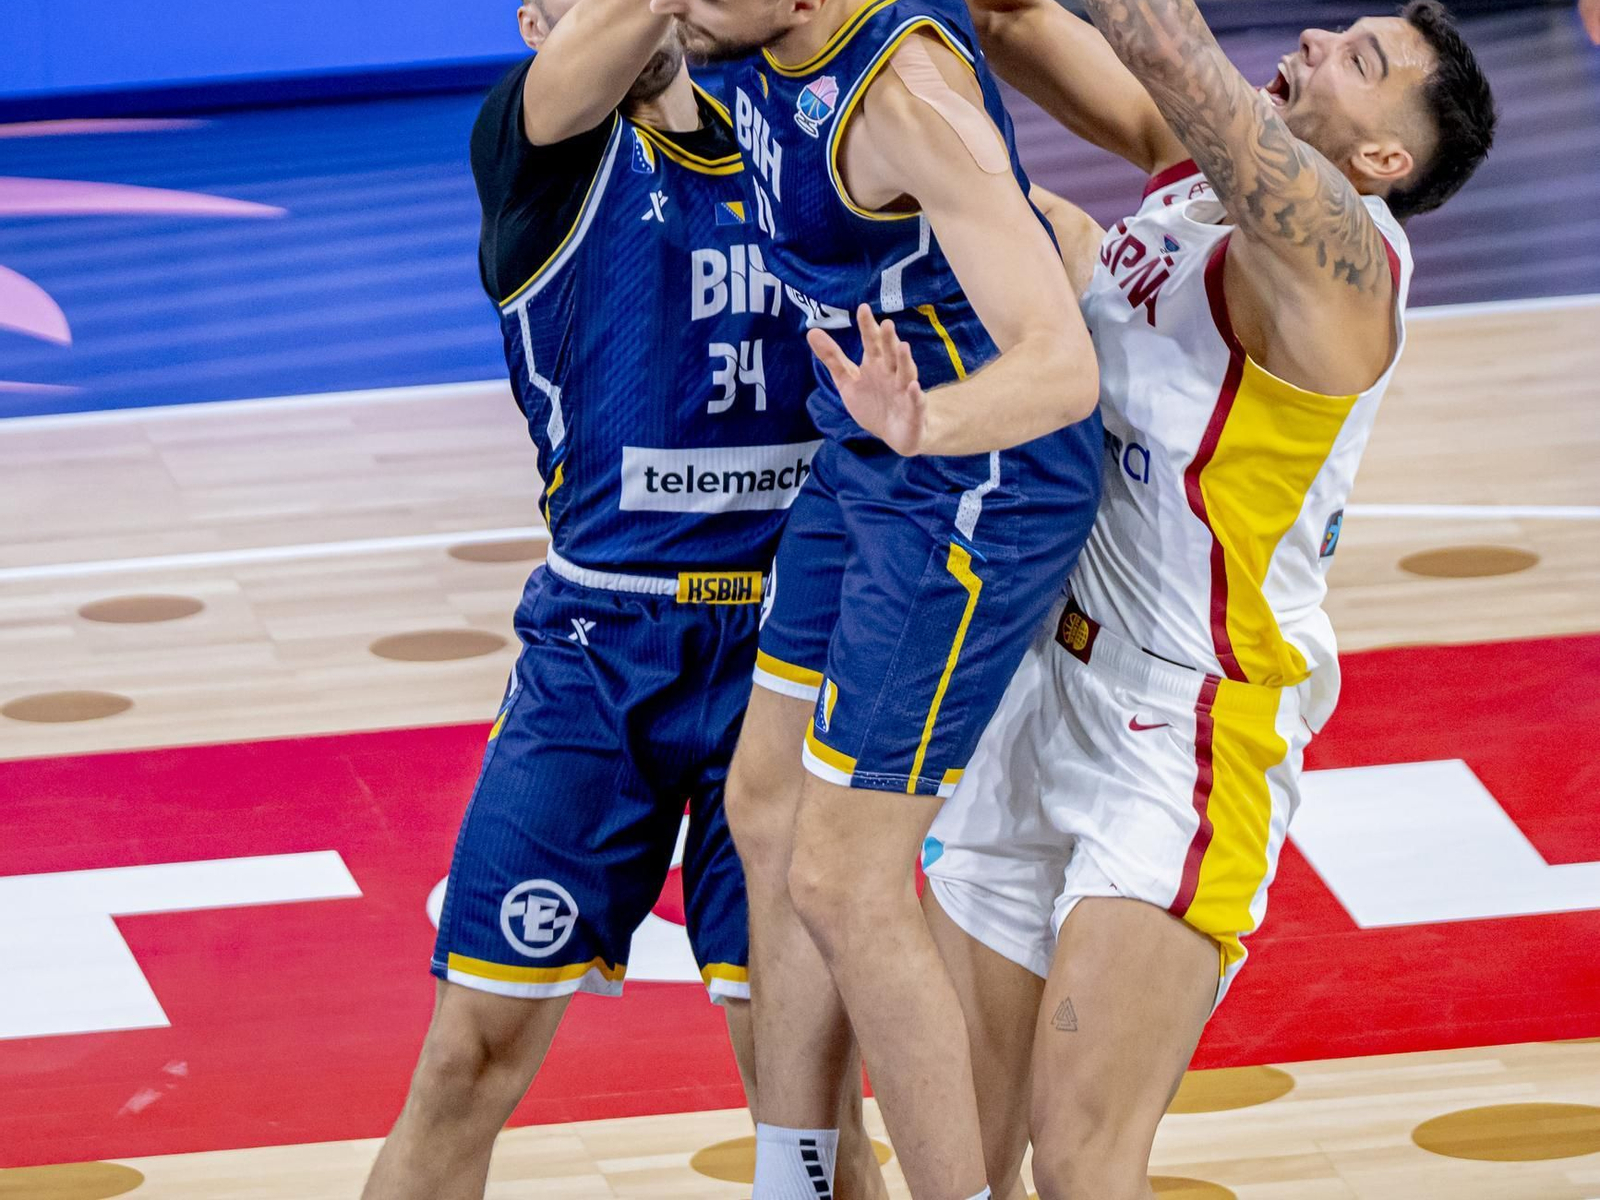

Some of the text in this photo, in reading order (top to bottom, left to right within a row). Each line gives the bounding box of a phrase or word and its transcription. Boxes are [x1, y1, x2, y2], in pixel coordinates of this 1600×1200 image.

[735, 85, 783, 203] BIH
[707, 338, 767, 414] 34
[644, 458, 811, 494] telemach
[688, 576, 752, 602] HSBIH
